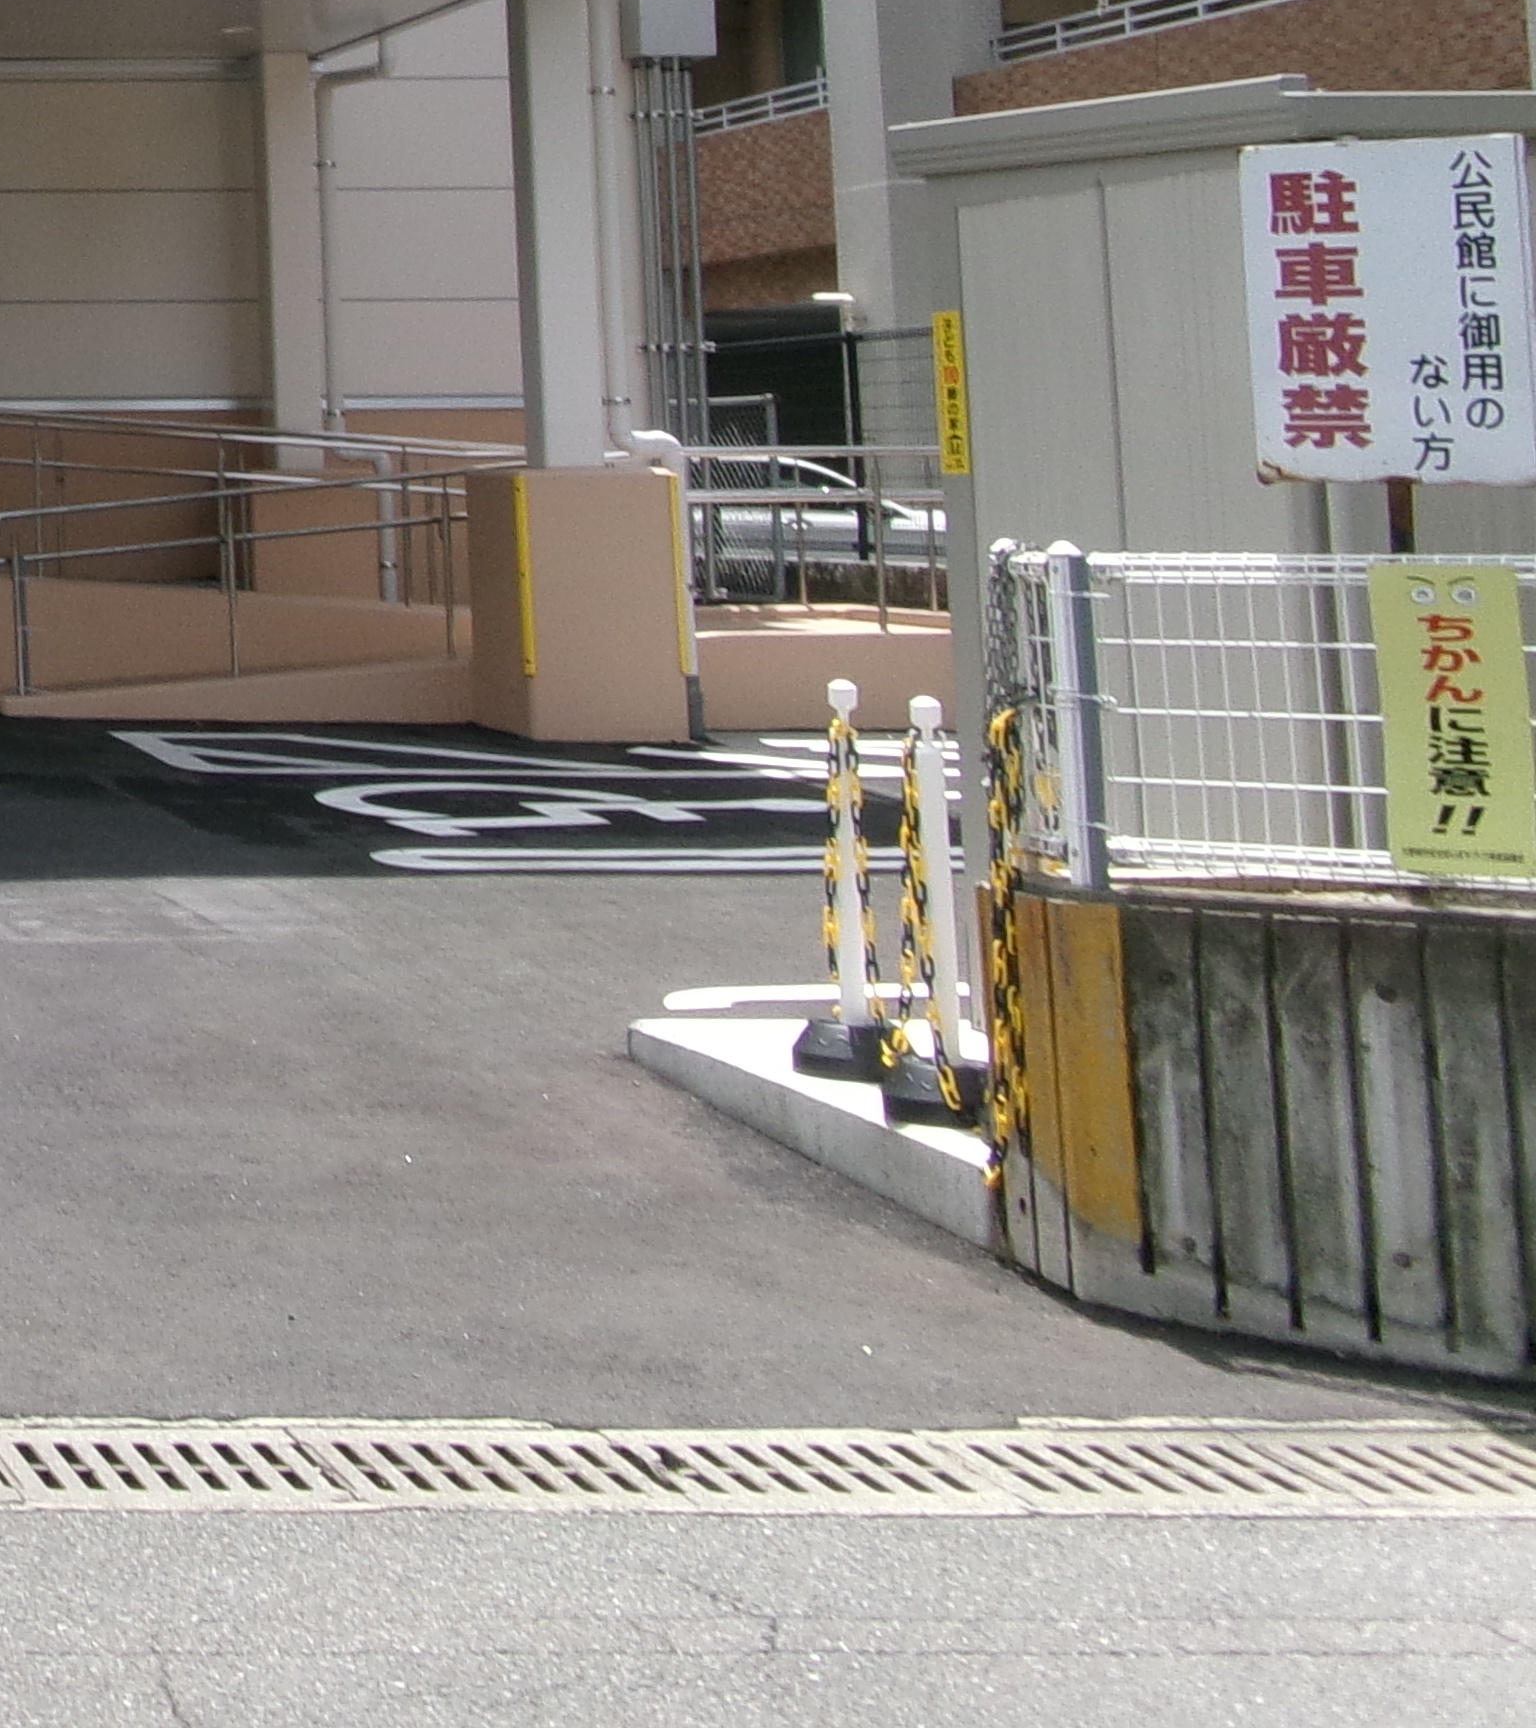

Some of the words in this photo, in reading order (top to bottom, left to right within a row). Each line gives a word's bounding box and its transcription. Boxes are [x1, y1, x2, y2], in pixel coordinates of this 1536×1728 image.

[1269, 170, 1374, 450] 駐車厳禁
[1410, 353, 1455, 472] ない方
[1449, 150, 1506, 430] 公民館に御用の
